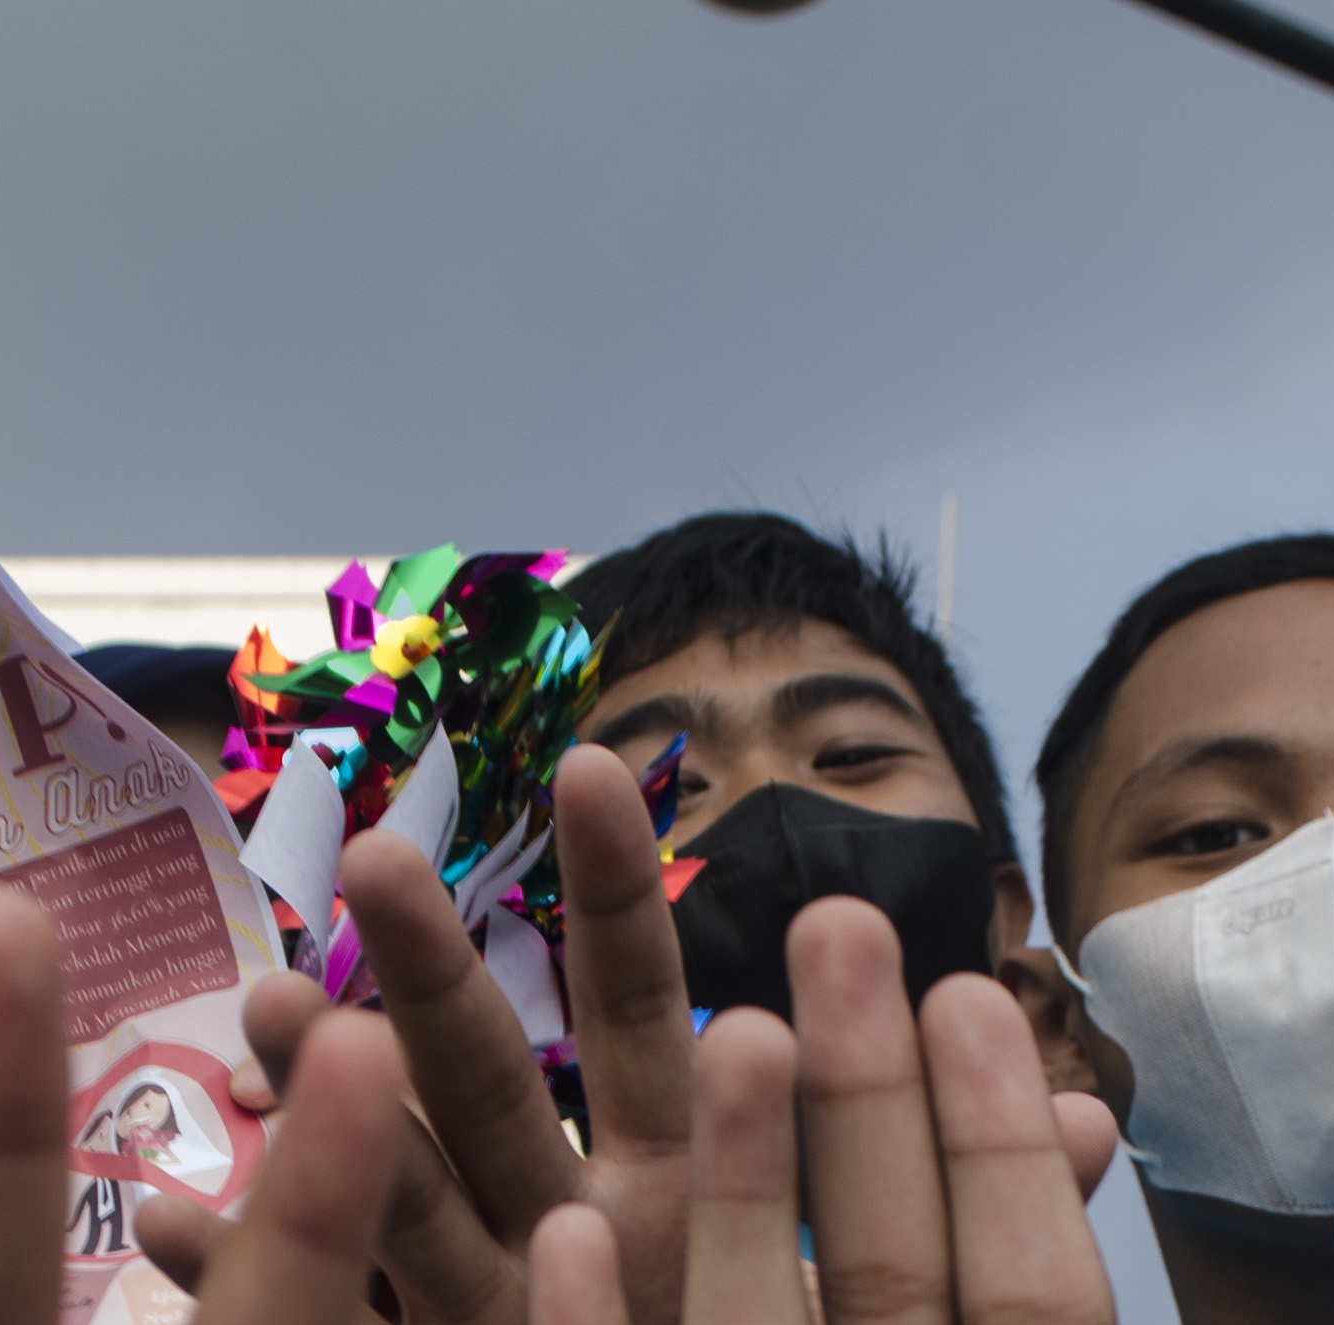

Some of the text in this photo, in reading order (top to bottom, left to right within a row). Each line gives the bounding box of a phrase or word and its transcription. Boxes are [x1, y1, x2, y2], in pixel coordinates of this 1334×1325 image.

[43, 741, 191, 836] Anak
[26, 837, 129, 890] pernikahan
[127, 829, 149, 853] di
[149, 818, 186, 845] usia
[74, 863, 155, 909] tertinggi
[154, 851, 200, 883] yang
[163, 882, 210, 916] yang
[123, 908, 219, 960] Menengah
[164, 941, 227, 981] hingga
